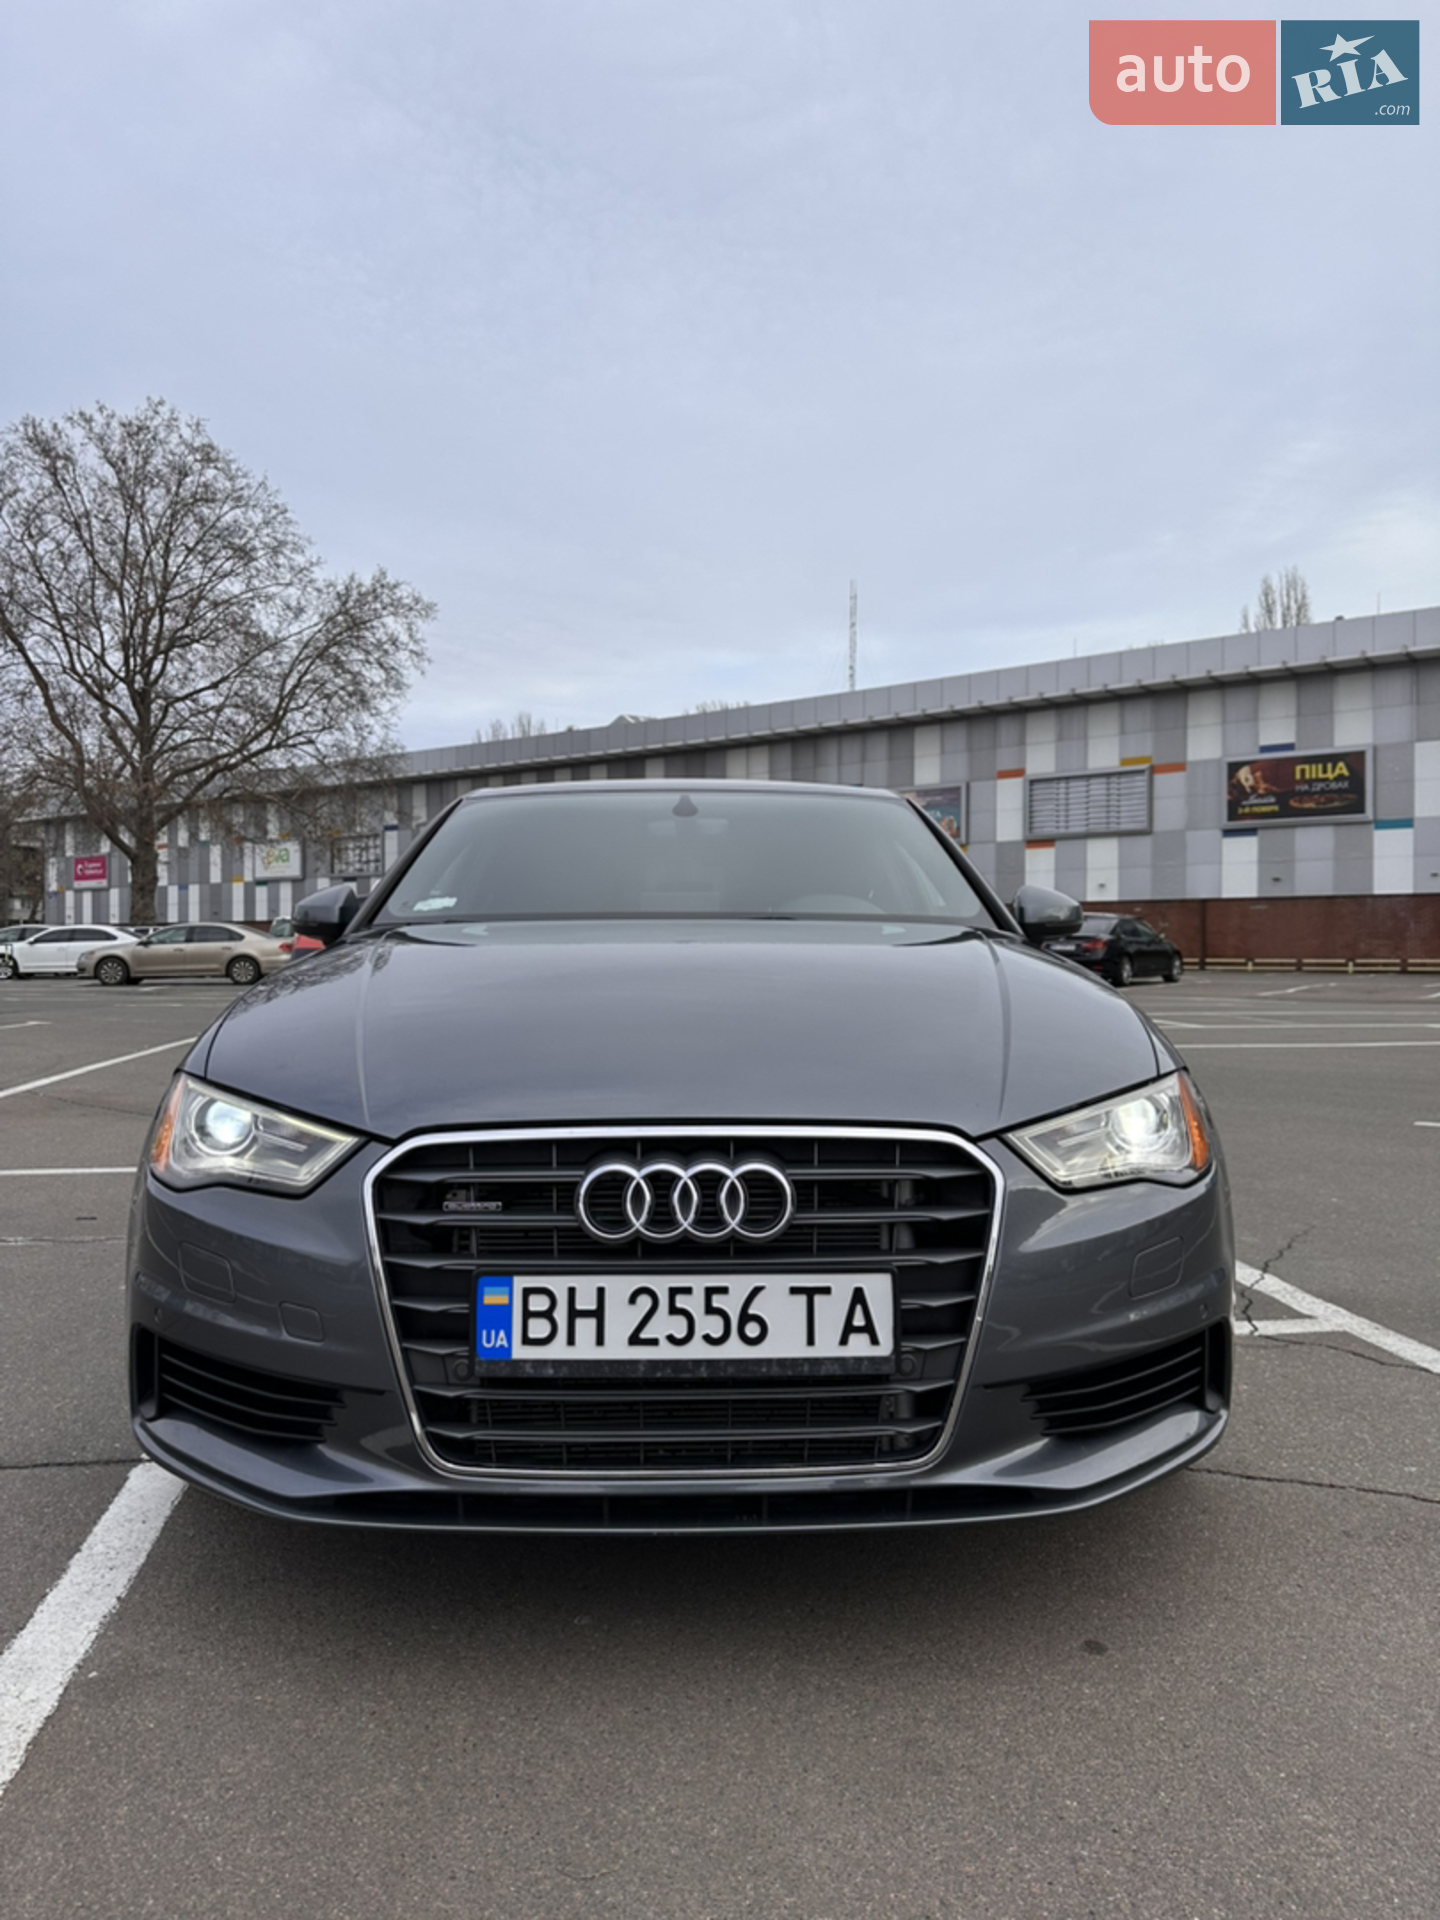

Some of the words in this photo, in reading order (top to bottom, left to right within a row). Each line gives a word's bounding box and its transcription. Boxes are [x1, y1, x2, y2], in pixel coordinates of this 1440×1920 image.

[1294, 761, 1349, 781] ПІЦА
[521, 1286, 606, 1347] BH
[627, 1285, 769, 1347] 2556
[789, 1285, 881, 1347] TA
[481, 1329, 509, 1349] UA
